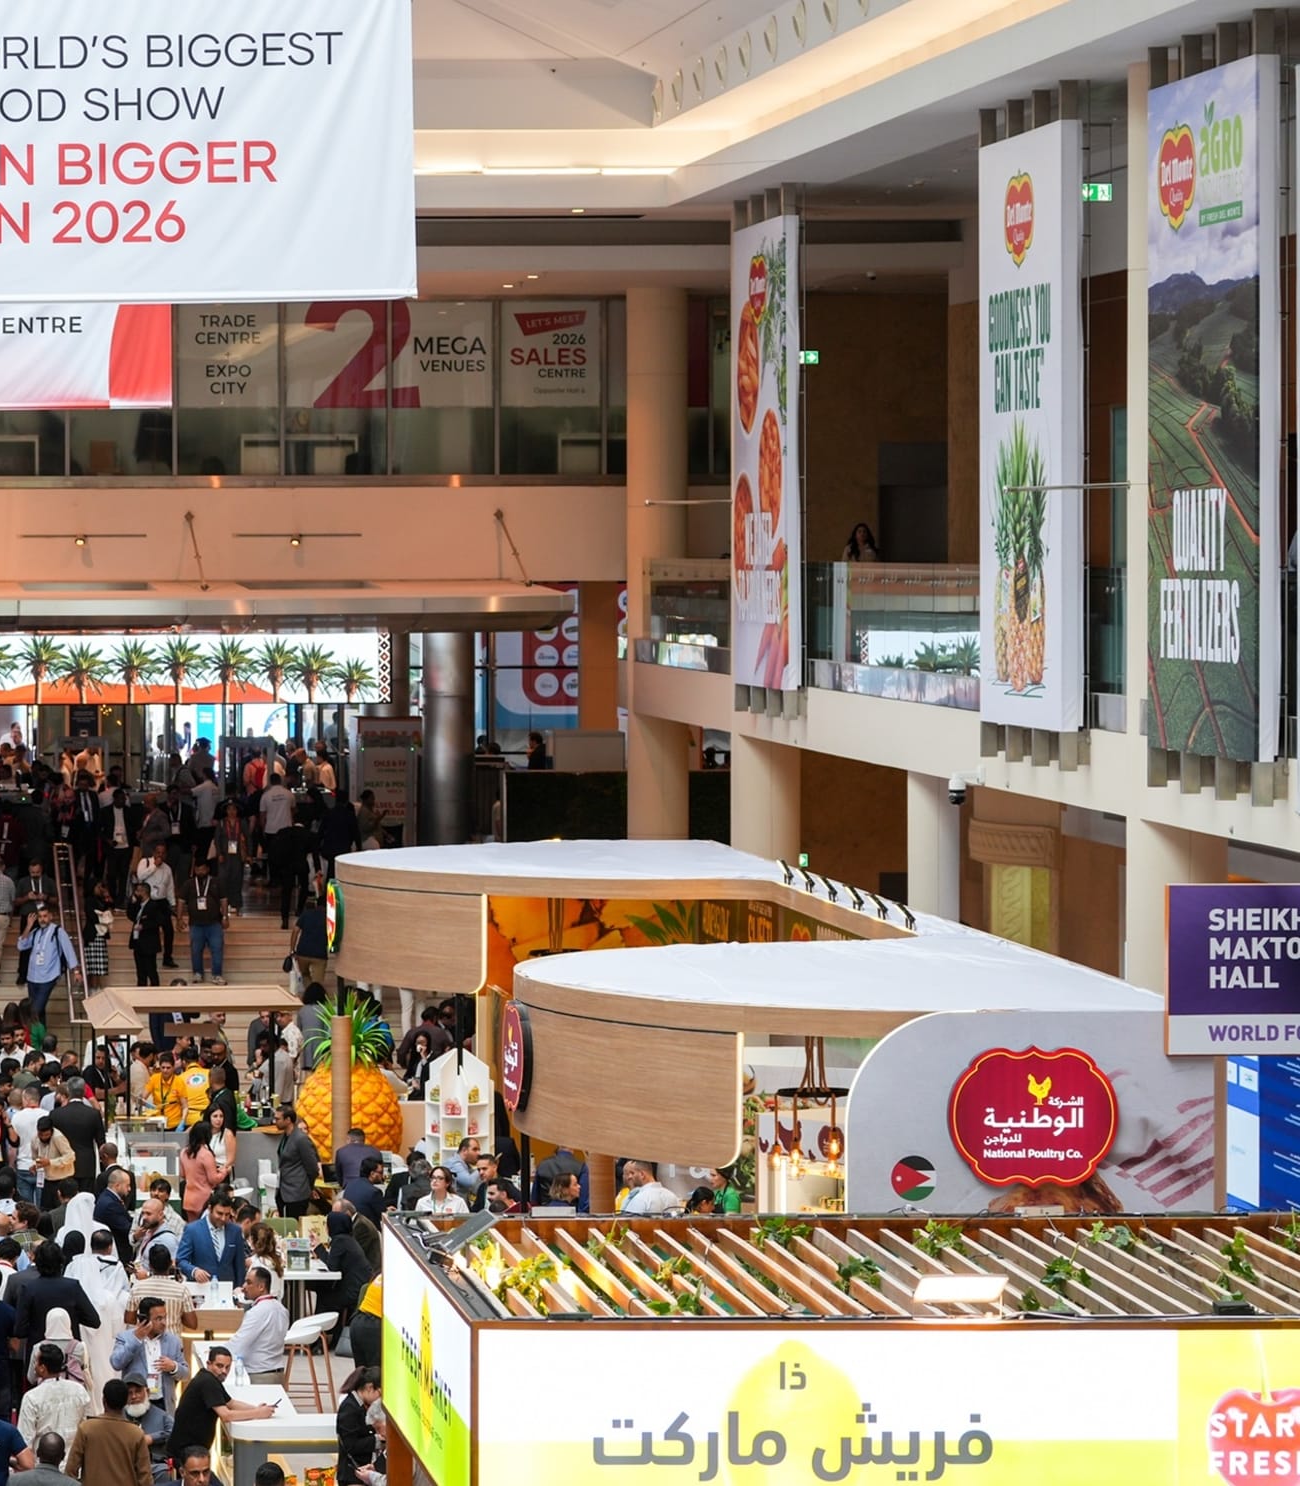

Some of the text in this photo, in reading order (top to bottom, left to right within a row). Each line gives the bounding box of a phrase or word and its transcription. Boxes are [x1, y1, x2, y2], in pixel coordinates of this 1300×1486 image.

[146, 31, 343, 68] BIGGEST
[83, 86, 225, 122] SHOW
[57, 140, 278, 186] BIGGER
[52, 199, 187, 245] 2026
[199, 314, 257, 328] TRADE
[989, 282, 1051, 353] GOODNESS YOU
[195, 331, 262, 345] CENTRE
[413, 336, 487, 355] MEGA
[552, 333, 586, 345] 2026
[303, 301, 421, 408] 2
[510, 347, 588, 366] SALES
[205, 364, 252, 378] EXPO
[420, 359, 486, 373] VENUES
[538, 368, 587, 378] CENTRE
[210, 381, 247, 395] CITY
[995, 352, 1011, 414] CAN
[1173, 488, 1227, 571] QUALITY
[1160, 578, 1240, 665] FERTILIZERS
[1209, 966, 1279, 989] HALL
[1208, 1025, 1279, 1042] WORLD
[1047, 1096, 1084, 1109] الشركة
[983, 1107, 1084, 1137] الوطنية
[983, 1133, 1022, 1146] للدواجن
[983, 1148, 1083, 1161] National Poultry Co.
[779, 1361, 807, 1390] ذا
[593, 1402, 994, 1482] فريش ماركت
